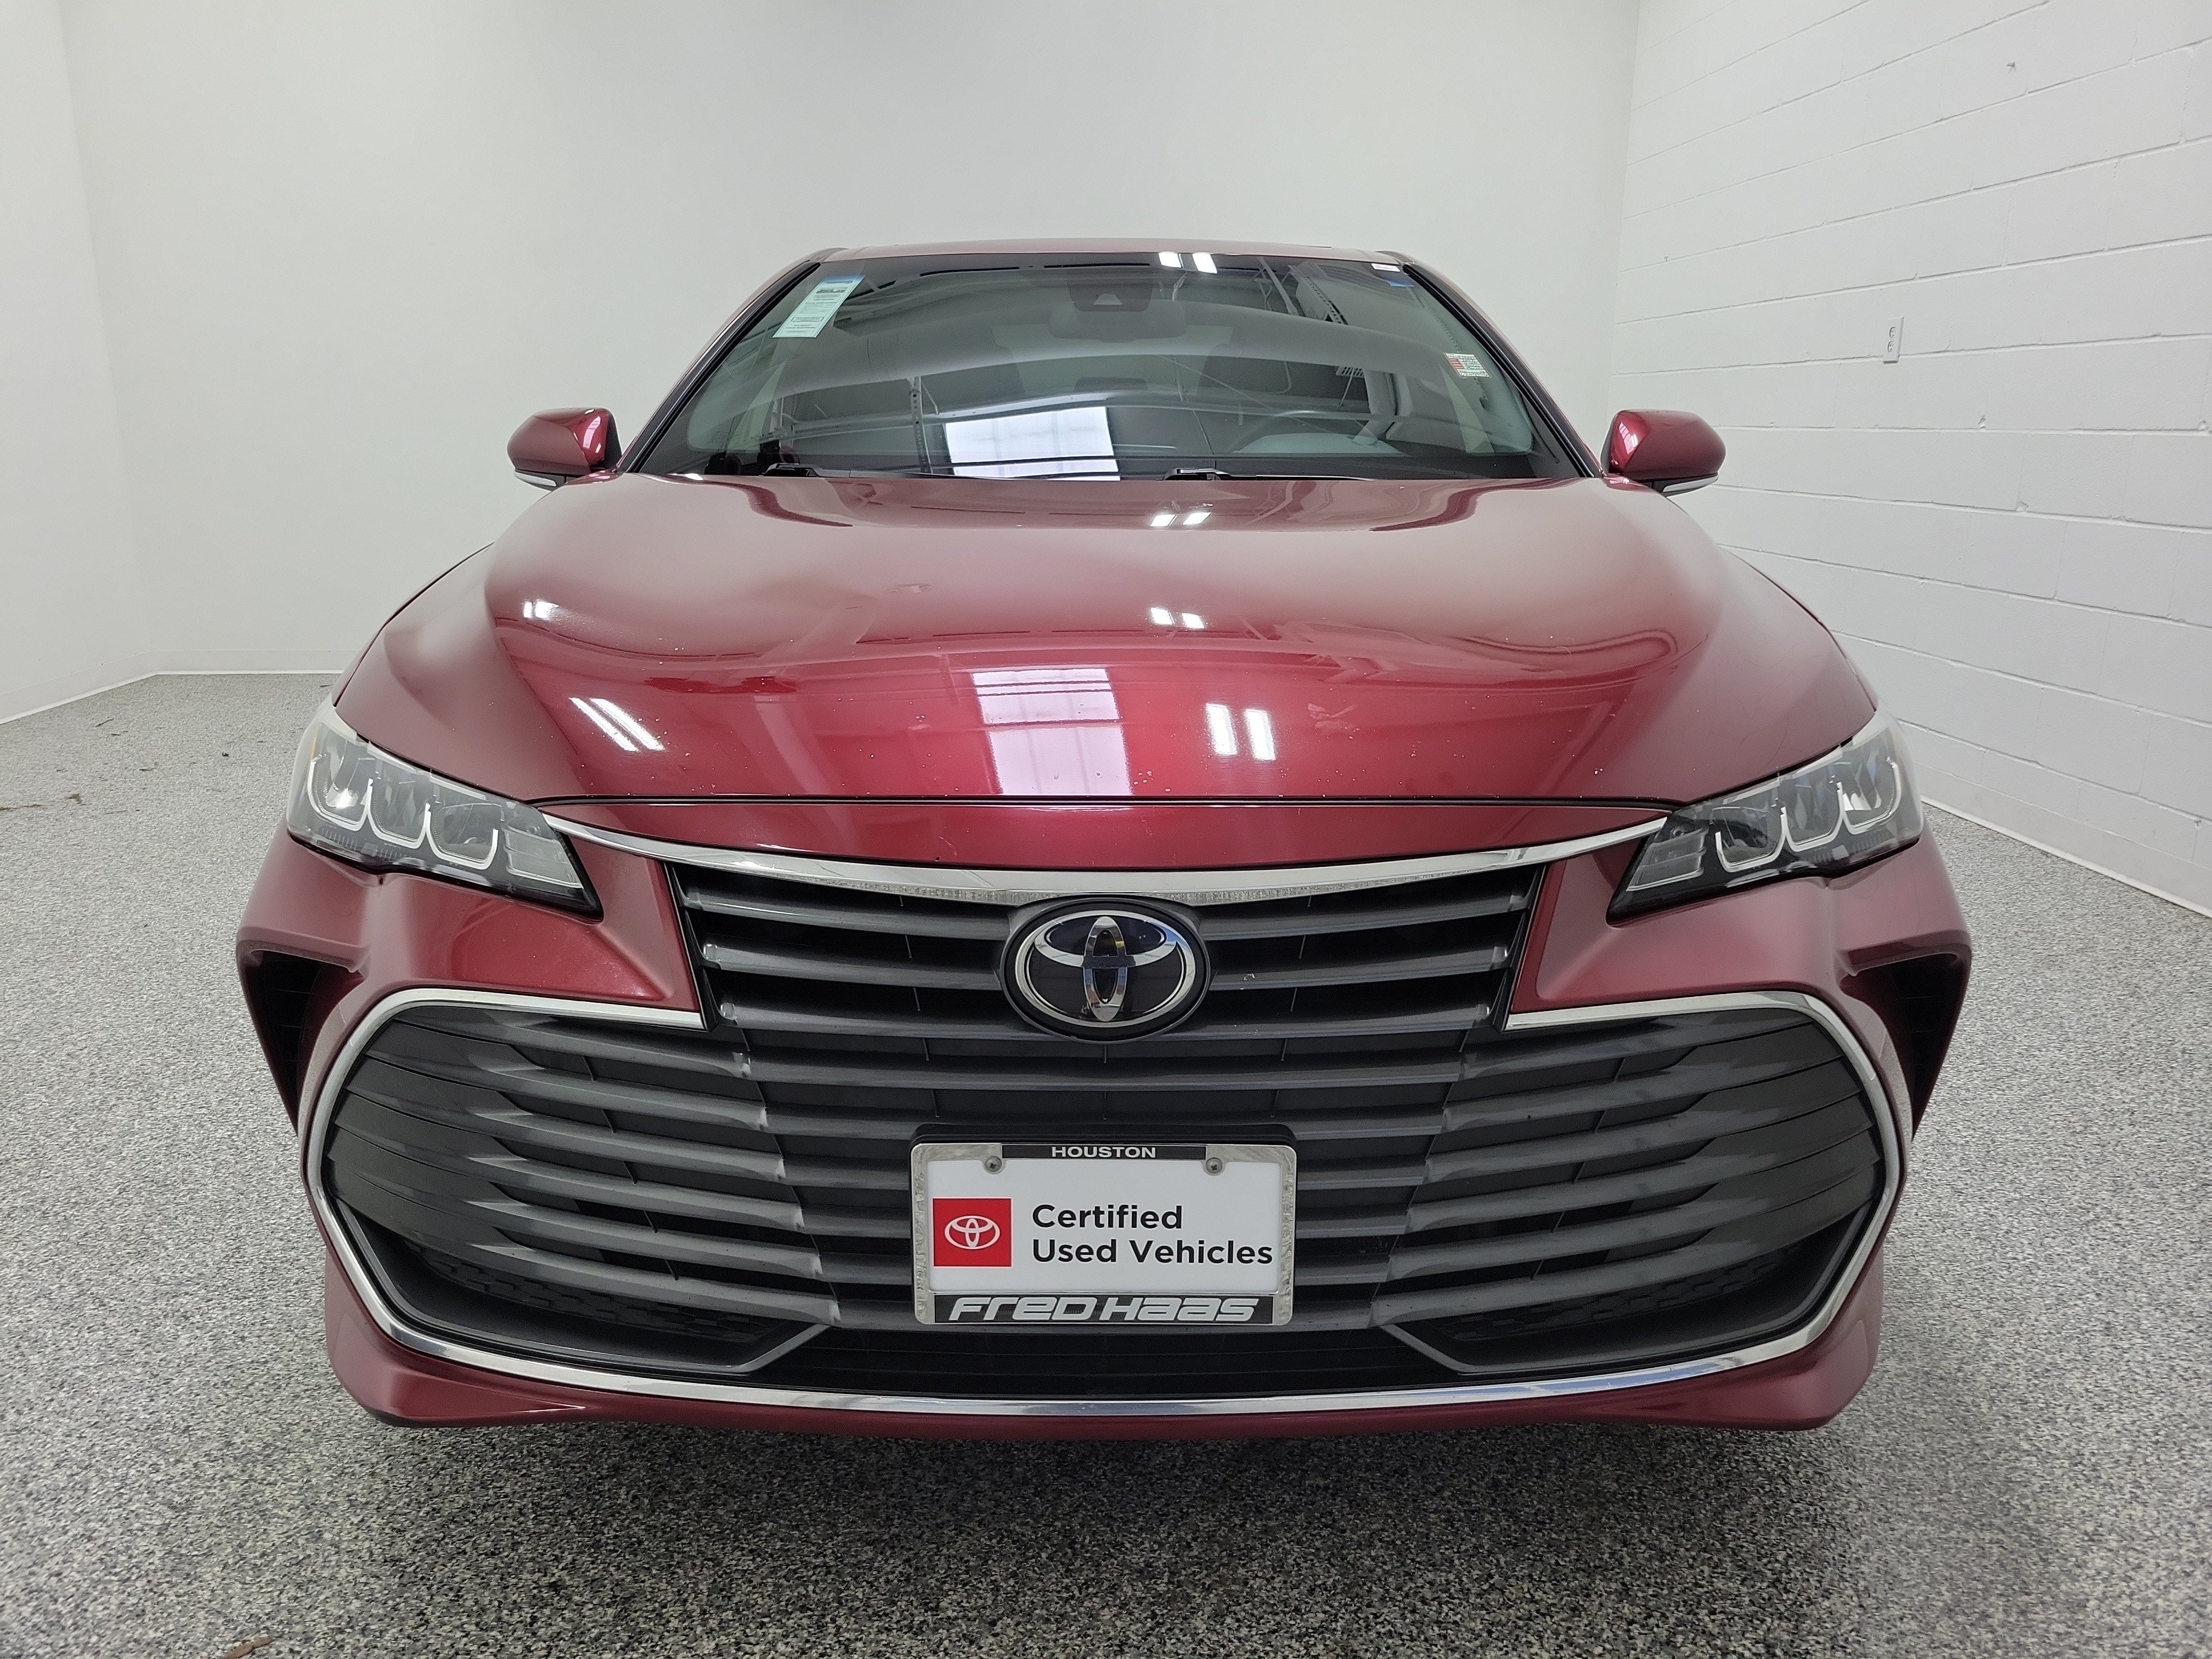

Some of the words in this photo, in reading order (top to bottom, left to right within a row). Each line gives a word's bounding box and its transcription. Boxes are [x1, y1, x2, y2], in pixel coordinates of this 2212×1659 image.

[1051, 1146, 1156, 1158] HOUSTON
[1032, 1204, 1182, 1229] Certified
[1033, 1238, 1117, 1262] Used
[1128, 1239, 1273, 1265] Vehicles
